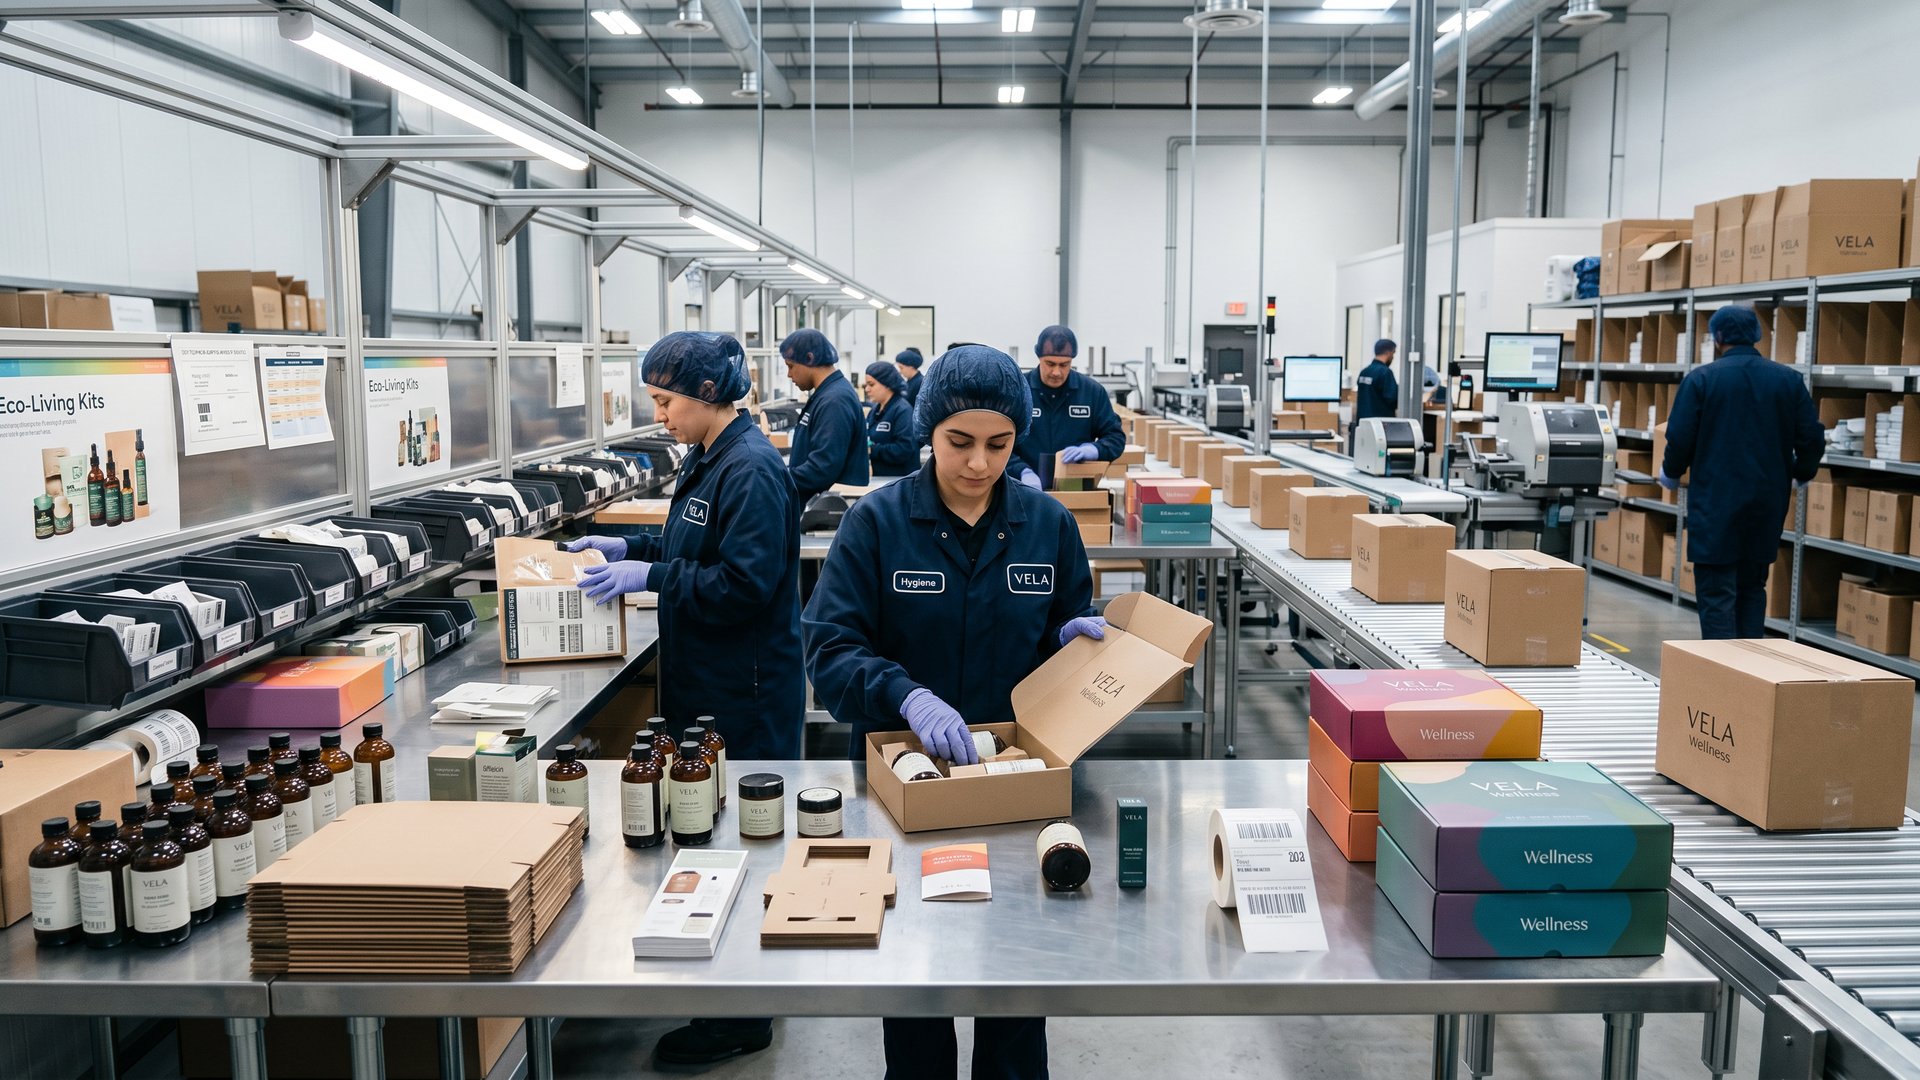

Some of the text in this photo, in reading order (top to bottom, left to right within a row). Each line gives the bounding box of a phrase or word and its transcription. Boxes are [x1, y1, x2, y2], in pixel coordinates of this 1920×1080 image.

[1835, 235, 1874, 248] VELA
[213, 304, 242, 315] VELA
[368, 377, 419, 394] Eco-Living Kits
[0, 391, 105, 416] Eco-Living Kits
[901, 577, 936, 588] Hygiene
[1013, 573, 1050, 585] VELA
[1456, 592, 1475, 615] VELA
[1092, 671, 1126, 698] VELA
[1382, 680, 1455, 688] VELA
[1687, 705, 1735, 747] VELA
[1419, 728, 1475, 741] Wellness
[1688, 734, 1731, 764] Wellness
[679, 788, 699, 796] VELA
[1470, 781, 1559, 791] VELA
[1489, 790, 1561, 798] Wellness
[1523, 849, 1594, 865] Wellness
[142, 878, 168, 888] VELA
[1519, 917, 1589, 932] Wellness
